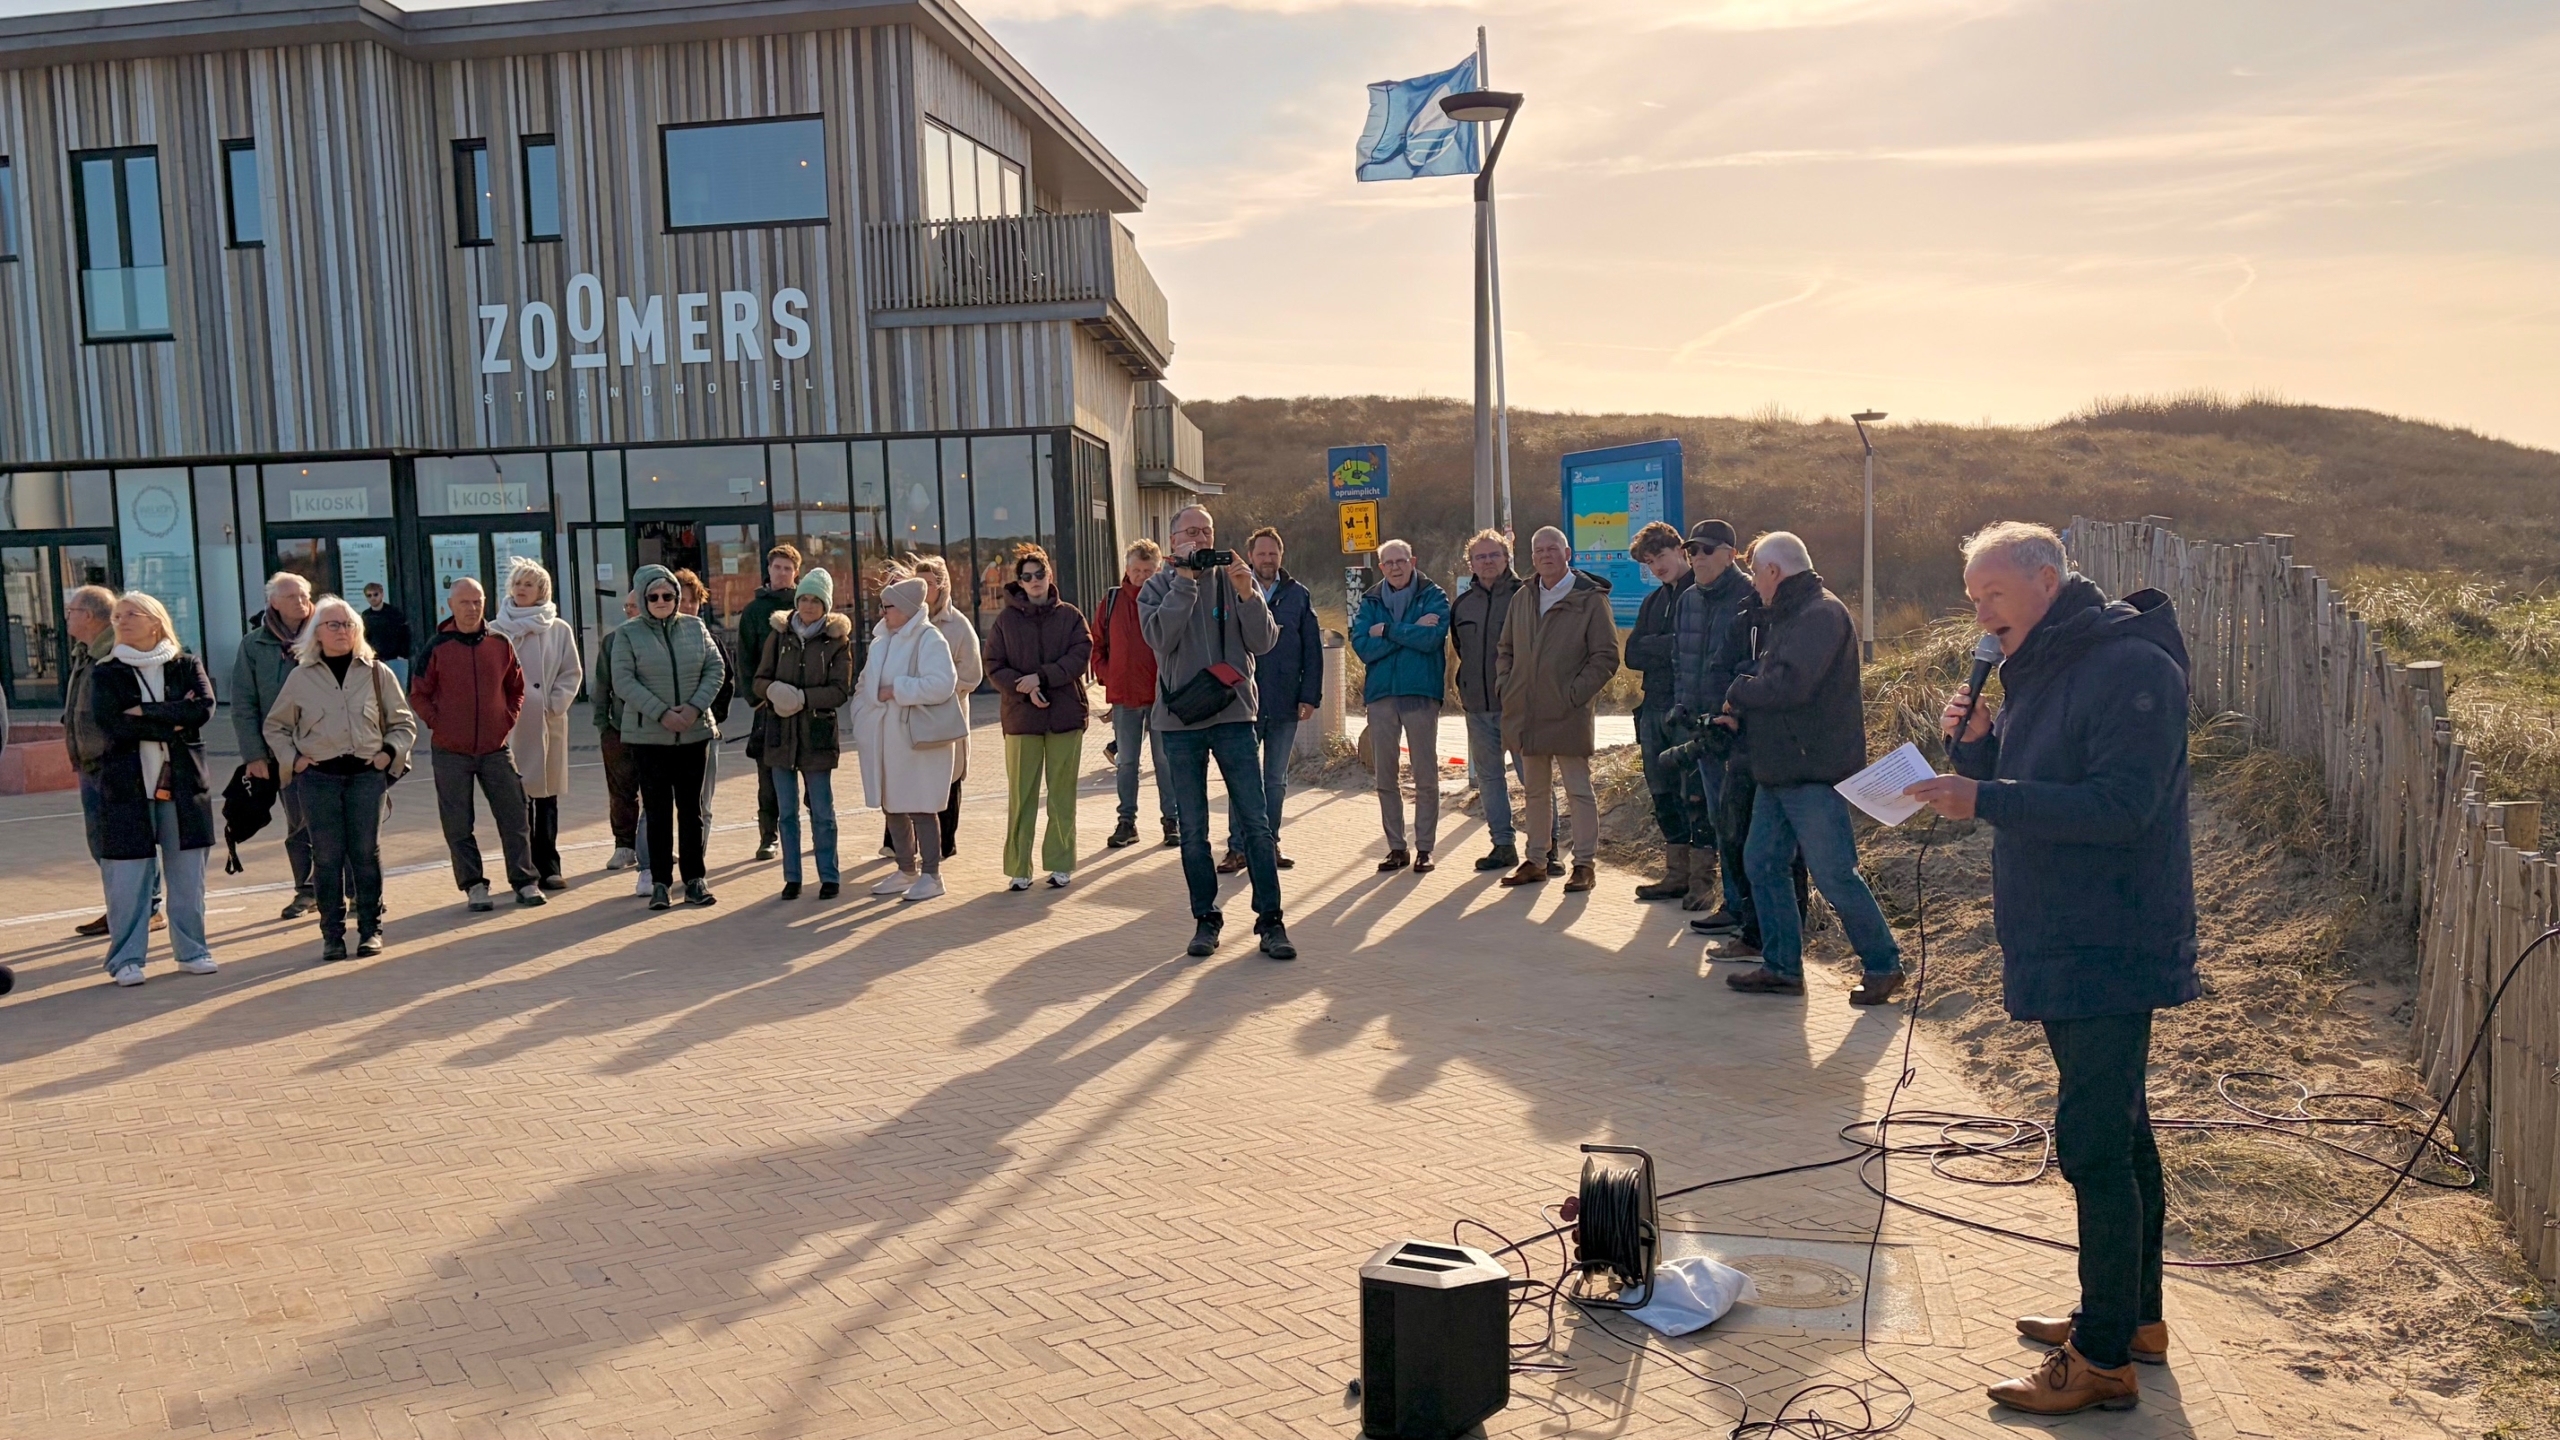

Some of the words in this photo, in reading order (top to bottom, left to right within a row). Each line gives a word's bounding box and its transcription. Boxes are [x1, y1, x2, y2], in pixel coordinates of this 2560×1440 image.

[479, 272, 811, 374] ZOOMERS
[484, 378, 814, 405] STRANDHOTEL
[463, 491, 514, 506] KIOSK
[1335, 487, 1380, 498] opruimplicht
[304, 496, 355, 511] KIOSK
[1346, 506, 1354, 514] 30
[1346, 532, 1354, 540] 24
